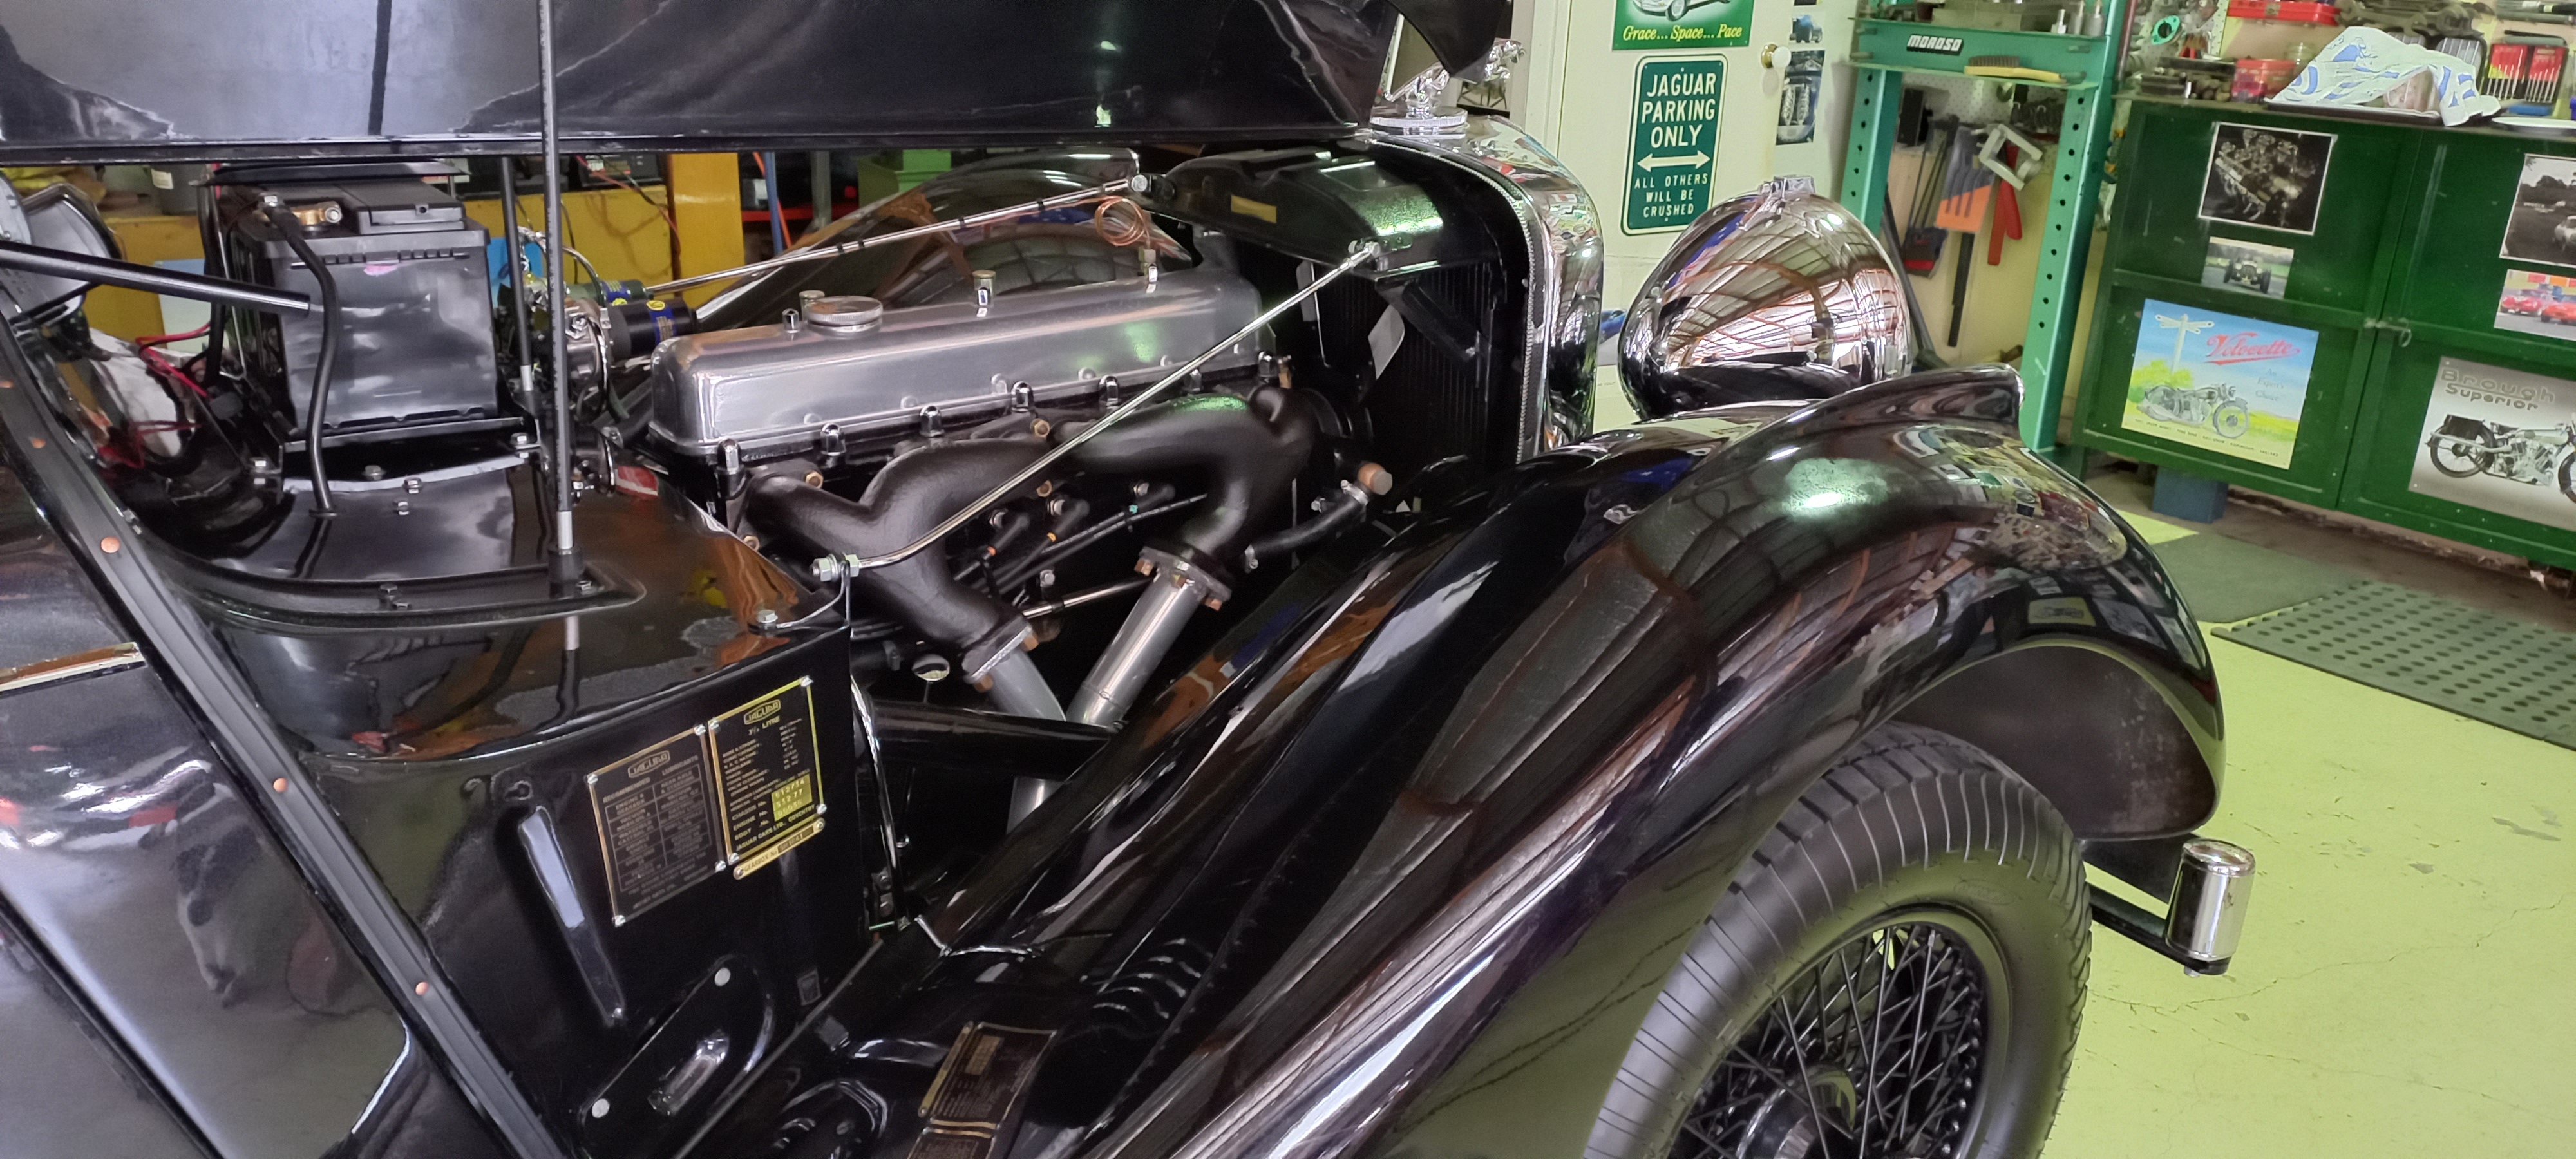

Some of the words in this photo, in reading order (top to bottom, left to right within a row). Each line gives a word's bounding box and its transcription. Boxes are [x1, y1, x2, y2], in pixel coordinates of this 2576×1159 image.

[1716, 23, 1743, 39] Pace
[1907, 35, 1963, 52] MOROSO
[1647, 73, 1716, 97] JAGUAR
[1641, 98, 1716, 124] PARKING
[1651, 124, 1703, 149] ONLY
[1634, 177, 1655, 189] ALL
[1665, 173, 1708, 187] OTHERS
[1646, 191, 1671, 203] WILL
[1681, 189, 1694, 201] BE
[1643, 203, 1694, 218] CRUSHED
[2204, 332, 2300, 365] Velocette
[2441, 368, 2555, 403] Brough
[2445, 382, 2539, 411] Superior
[746, 701, 778, 722] JAGUAR
[630, 753, 667, 775] JAGUAR
[734, 816, 755, 831] ENGINE
[759, 827, 772, 838] CARS
[789, 804, 814, 822] COVENTRY
